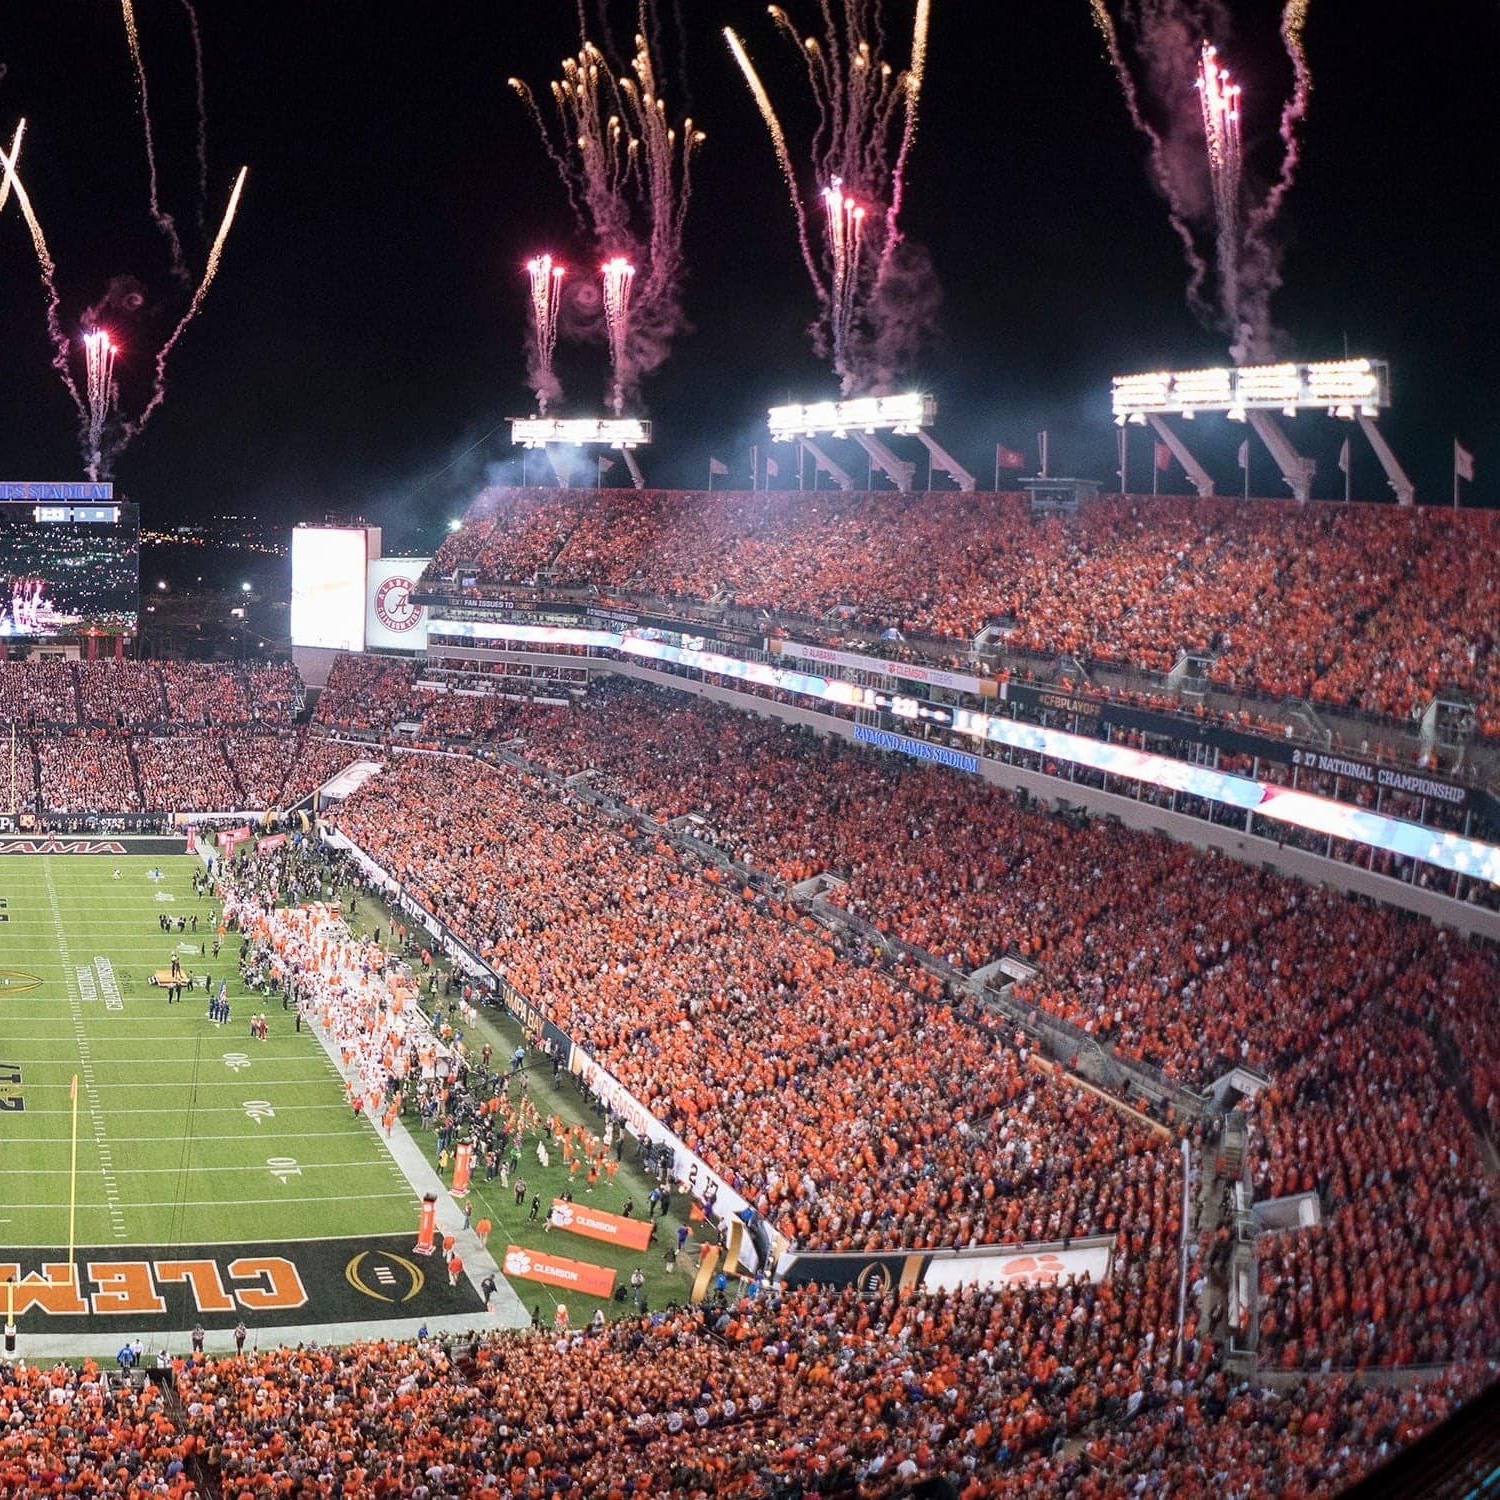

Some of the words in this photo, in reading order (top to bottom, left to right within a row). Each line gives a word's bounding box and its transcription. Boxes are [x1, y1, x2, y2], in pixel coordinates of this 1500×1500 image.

[28, 484, 110, 499] STADIUM
[896, 666, 928, 682] CLEMSON
[853, 724, 901, 751] RAYMOND
[900, 738, 932, 758] JAMES
[932, 745, 979, 773] STADIUM
[1318, 755, 1374, 782] NATIONAL
[1377, 769, 1466, 803] CHAMPIONSHIP
[500, 983, 526, 1022] TAMPA
[526, 1011, 546, 1036] BAY
[266, 1157, 302, 1176] 10
[575, 1215, 618, 1234] CLEMSON
[533, 1262, 579, 1281] CLEMSON
